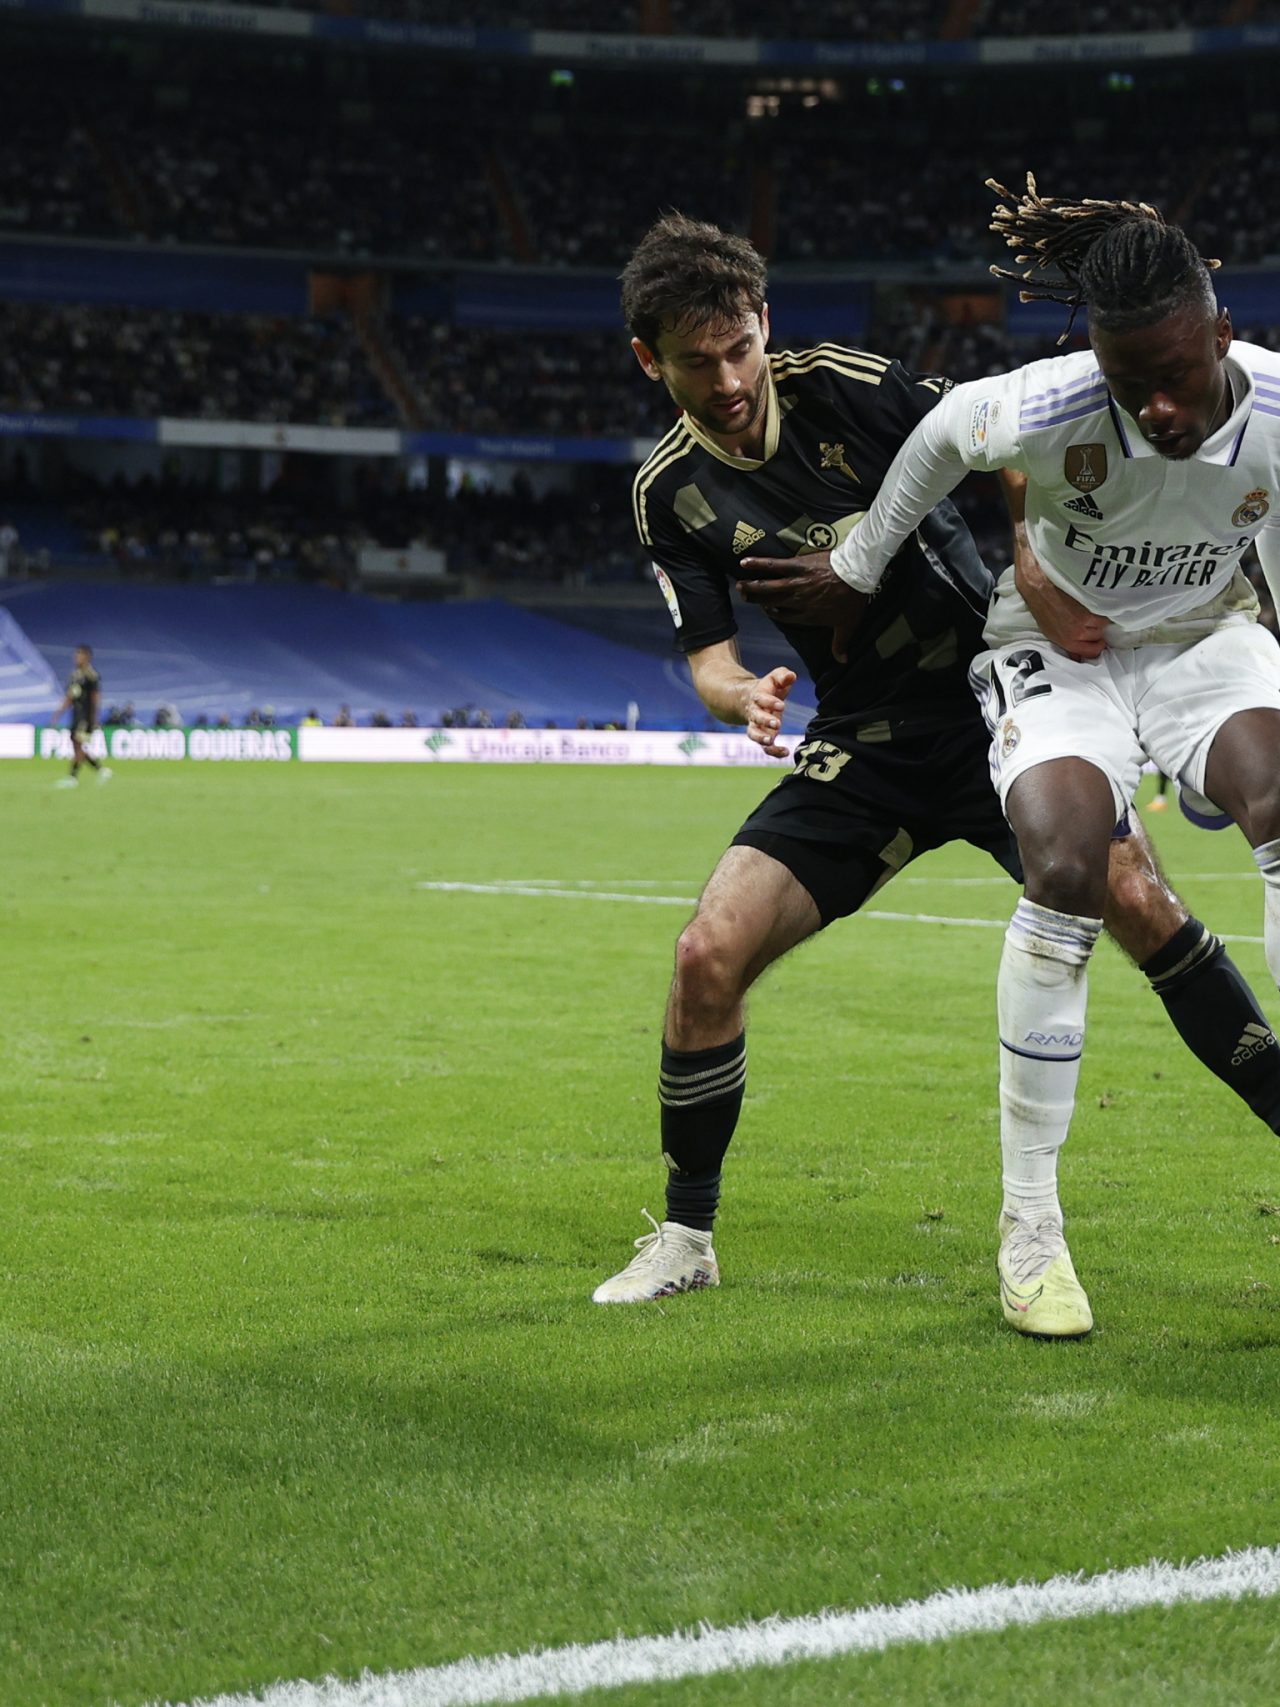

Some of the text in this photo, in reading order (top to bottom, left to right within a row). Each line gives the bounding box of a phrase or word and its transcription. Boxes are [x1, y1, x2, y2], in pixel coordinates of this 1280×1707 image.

[1063, 502, 1104, 520] adidas
[732, 528, 766, 555] adidas
[1082, 557, 1130, 590] FLY
[991, 649, 1052, 720] 12
[40, 728, 293, 761] PAA COMO QUIERAS
[1230, 1032, 1277, 1066] adida
